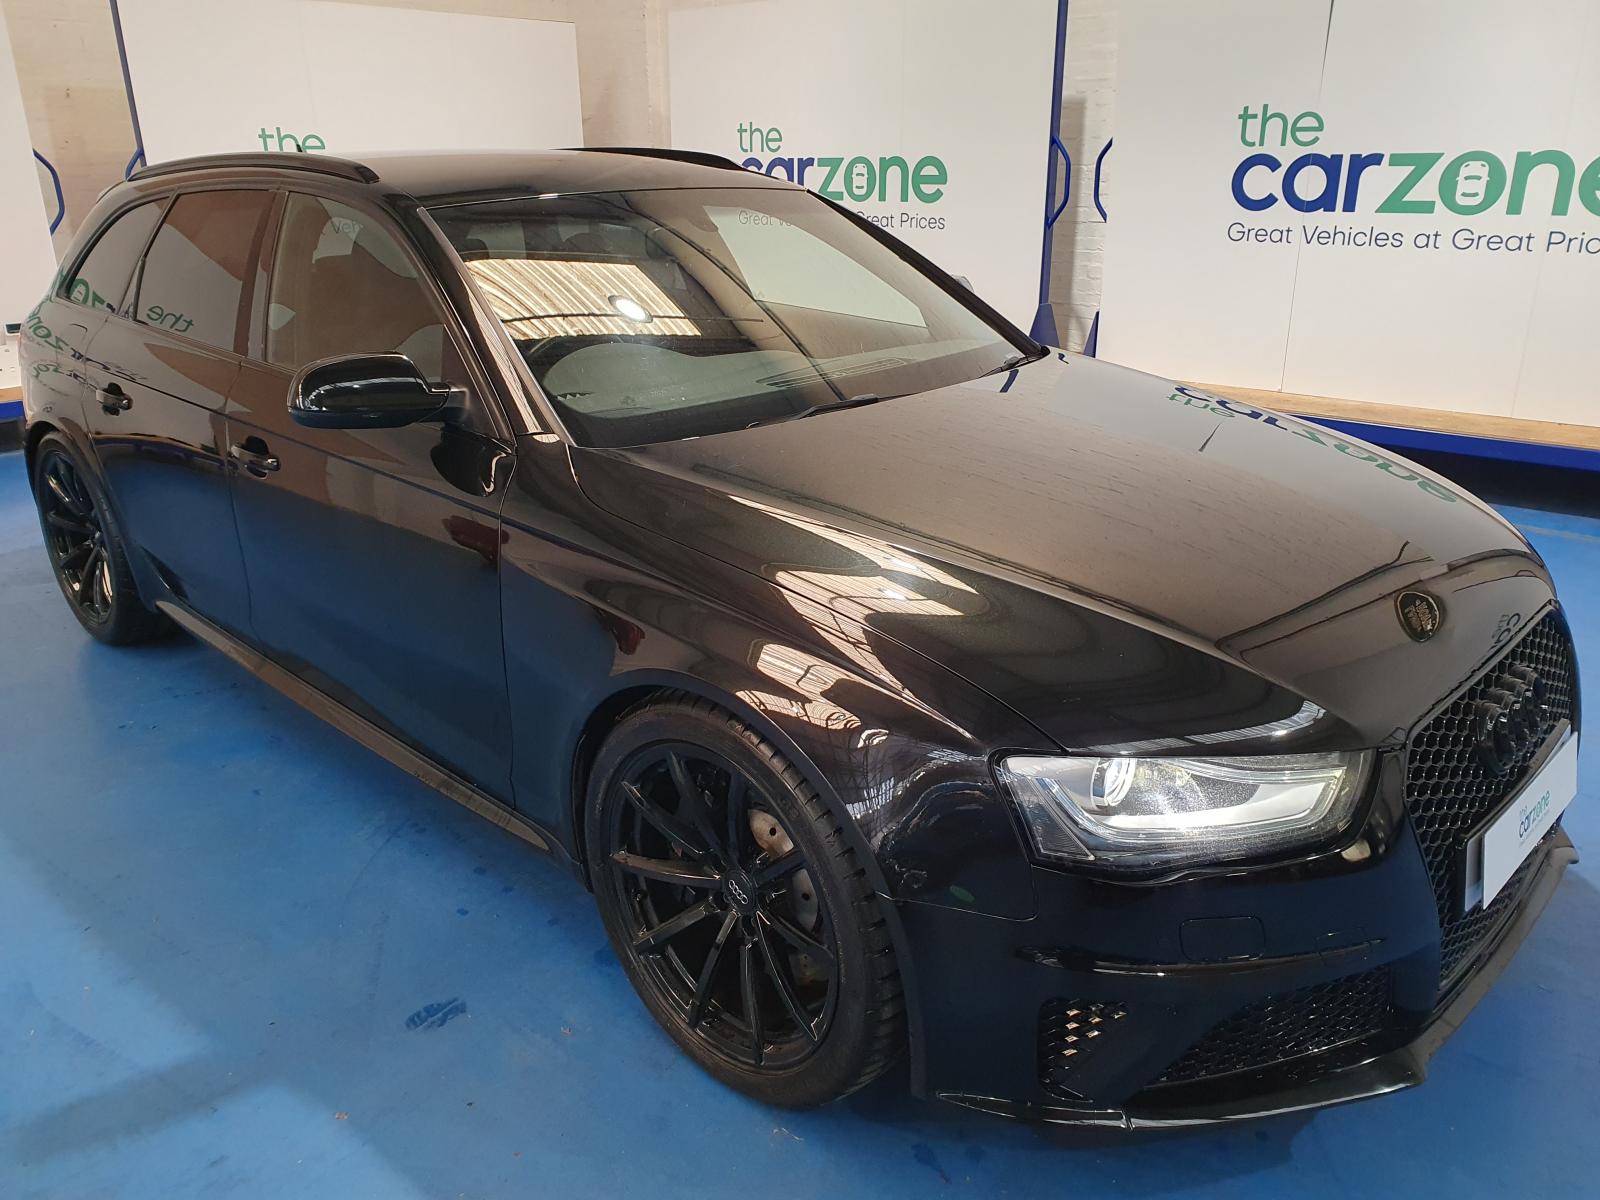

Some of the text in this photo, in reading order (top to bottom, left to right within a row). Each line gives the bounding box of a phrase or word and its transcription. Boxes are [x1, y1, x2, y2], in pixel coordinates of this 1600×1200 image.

[258, 126, 326, 152] the
[737, 121, 783, 153] the
[1238, 103, 1325, 147] the
[900, 212, 946, 230] Prices
[1227, 222, 1293, 244] Great
[1302, 225, 1404, 249] Vehicles
[1413, 230, 1442, 250] at
[1452, 228, 1535, 252] Great
